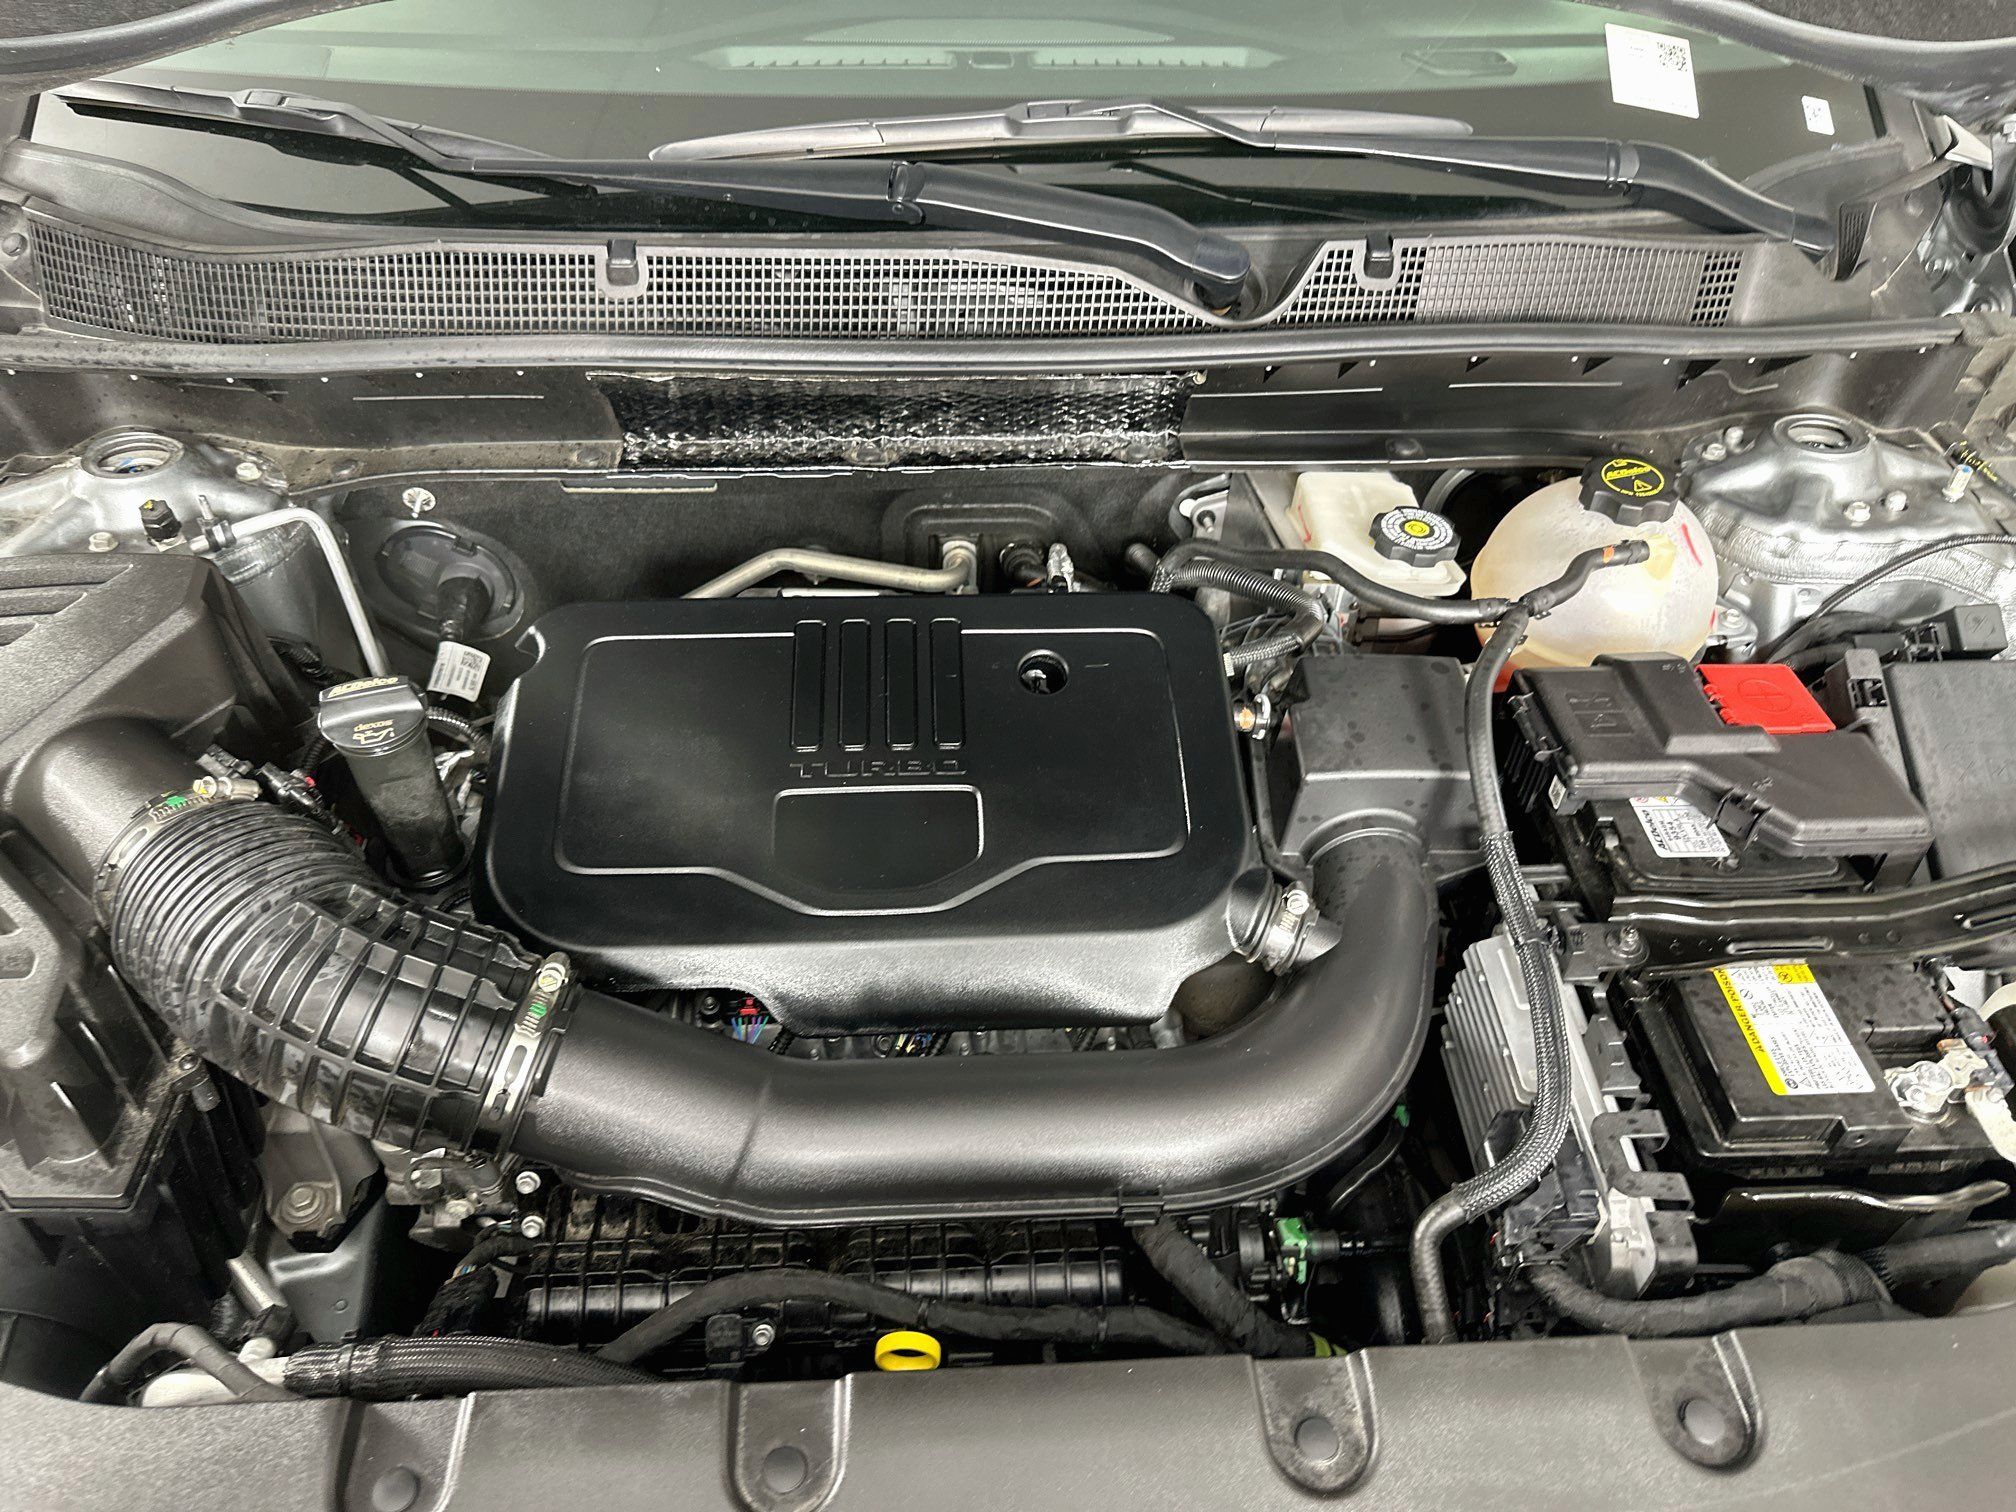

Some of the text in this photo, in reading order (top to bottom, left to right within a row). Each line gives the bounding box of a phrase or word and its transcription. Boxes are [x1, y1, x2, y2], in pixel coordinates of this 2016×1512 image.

[327, 676, 399, 698] ACDelco
[353, 719, 394, 732] dexos
[789, 759, 968, 778] TURBO
[1642, 809, 1668, 850] ACDelco
[1736, 1004, 1761, 1045] DANGER
